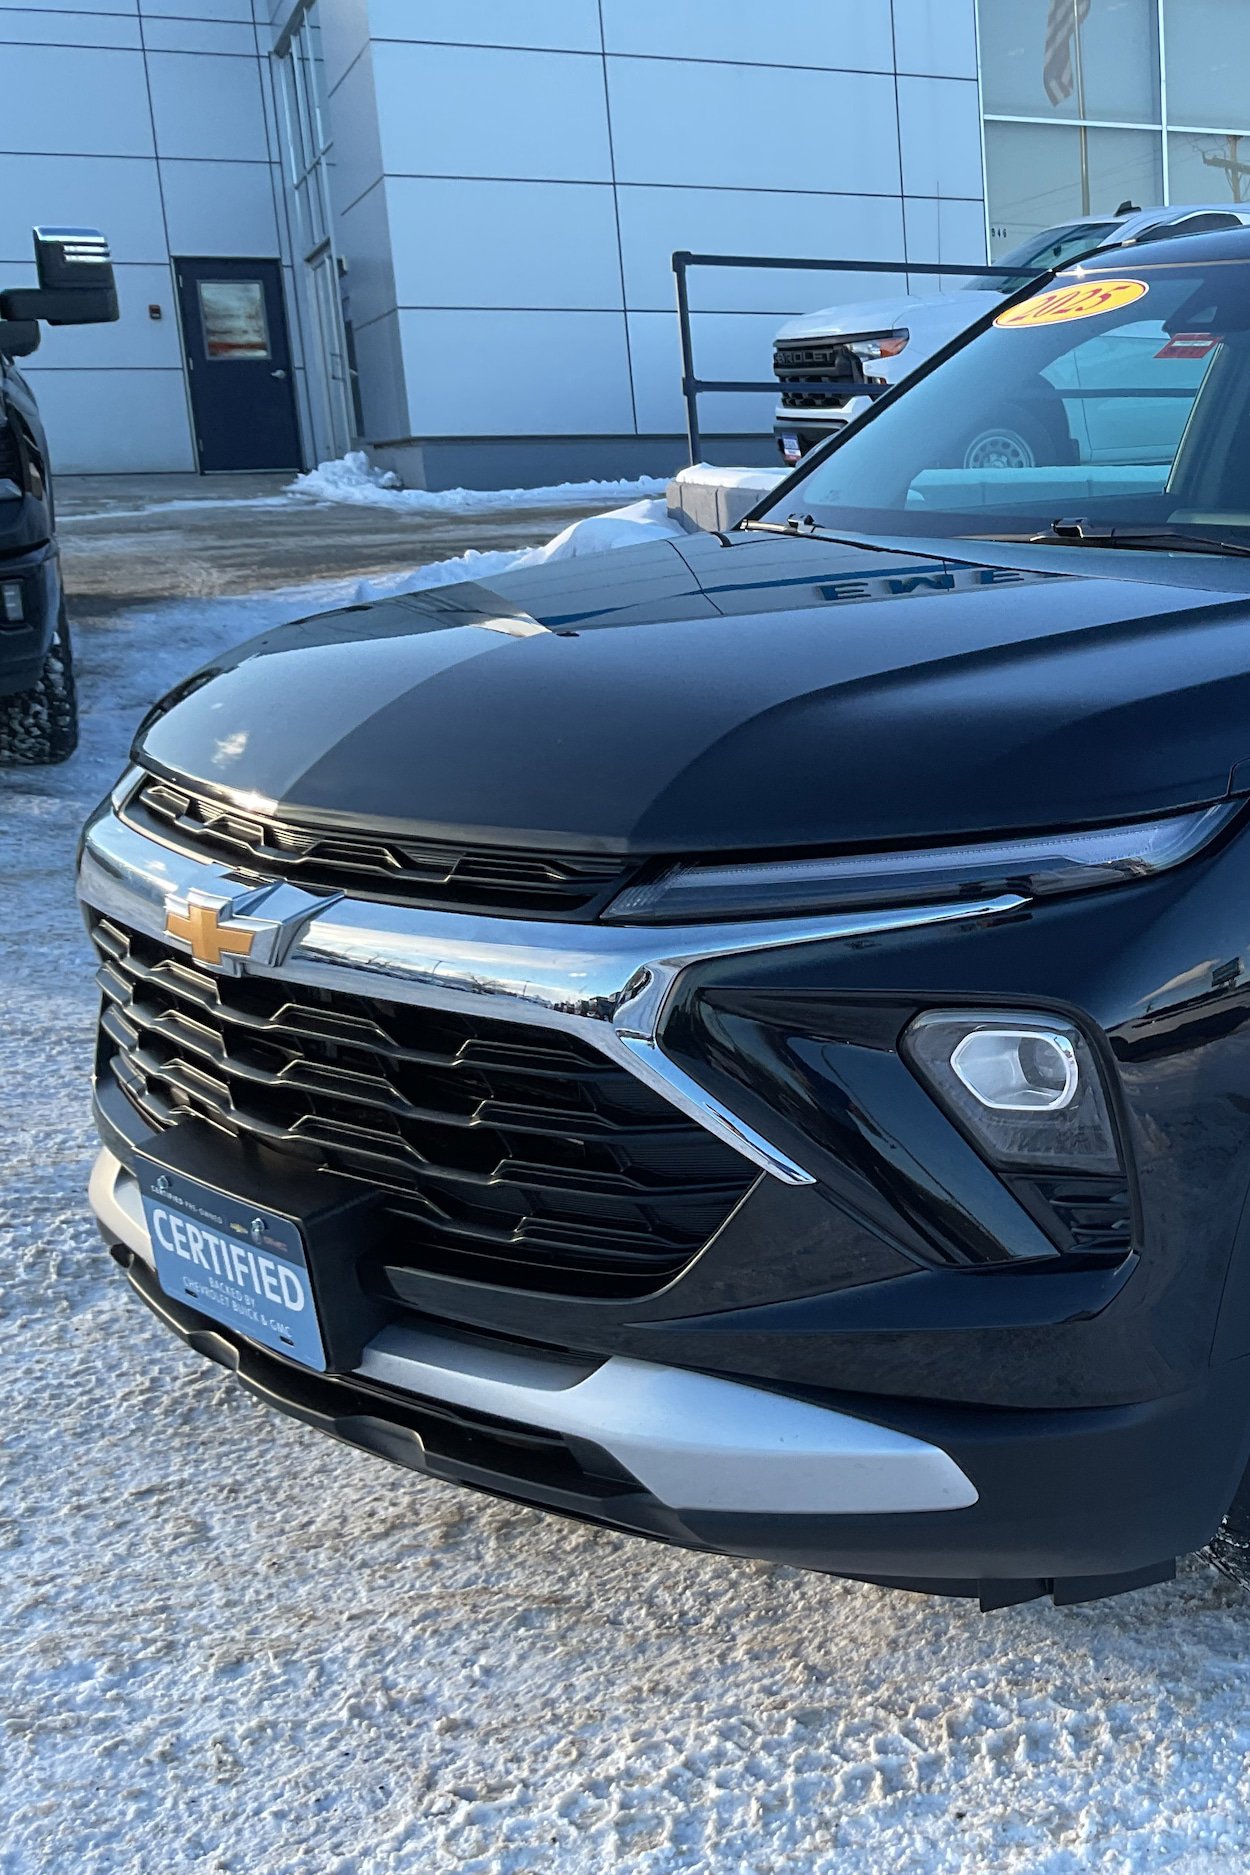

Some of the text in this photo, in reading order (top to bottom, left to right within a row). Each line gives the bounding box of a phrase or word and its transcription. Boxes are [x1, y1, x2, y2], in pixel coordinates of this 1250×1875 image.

[1007, 285, 1132, 323] 2025
[152, 1208, 305, 1312] CERTIFIED
[182, 1275, 231, 1308] CHEVROLET
[231, 1299, 260, 1323] BUICK
[269, 1317, 294, 1338] GMC
[208, 1276, 257, 1309] BACKED BY
